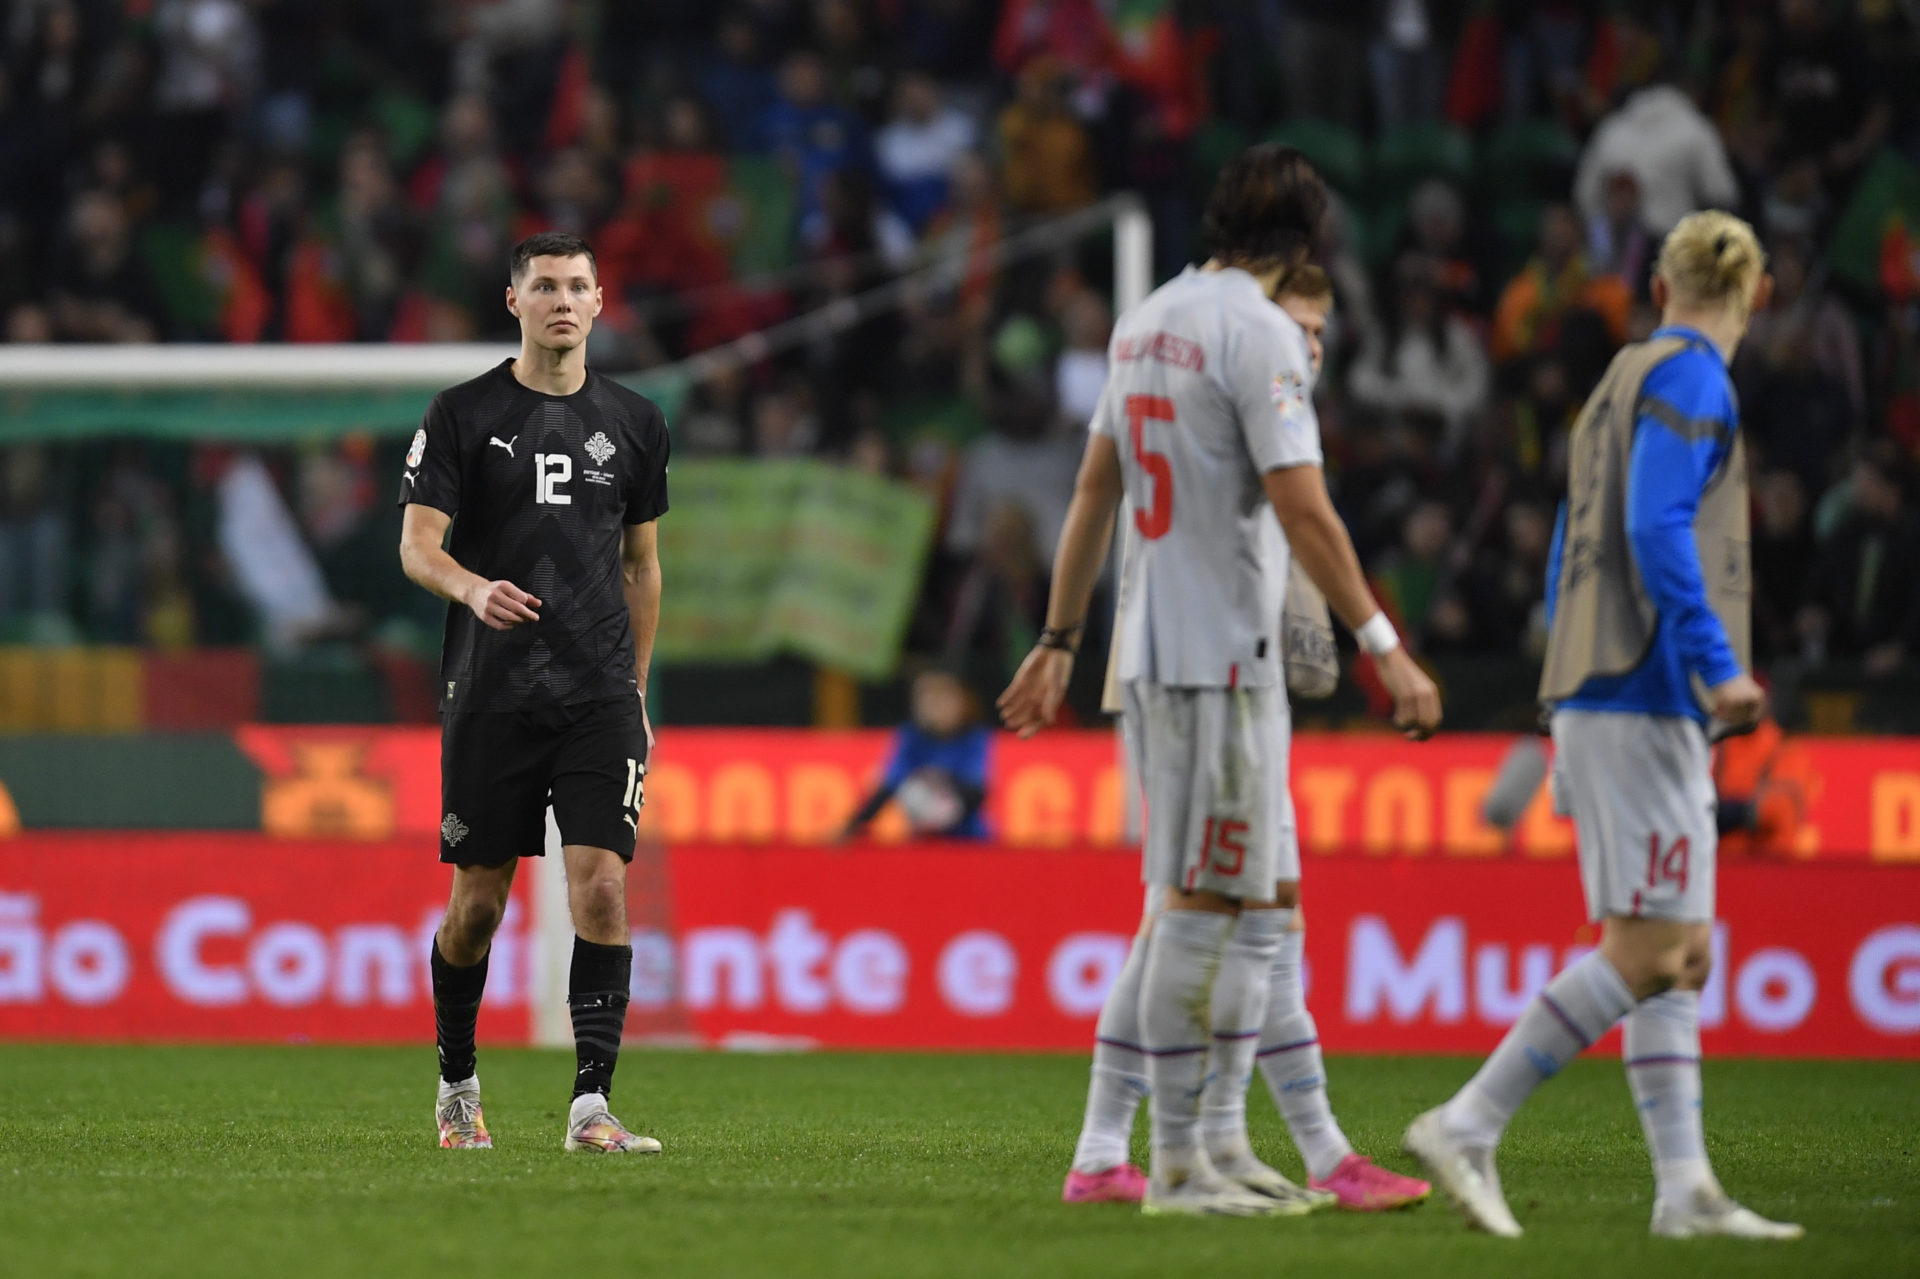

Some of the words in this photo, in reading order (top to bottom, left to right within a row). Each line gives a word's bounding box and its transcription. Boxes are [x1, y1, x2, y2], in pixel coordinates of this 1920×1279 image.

[535, 453, 572, 505] 12
[1199, 816, 1249, 877] 15
[1646, 832, 1690, 895] 14
[156, 894, 909, 1017] Coniente
[937, 931, 1018, 1018] e
[1344, 914, 1818, 1033] Muo
